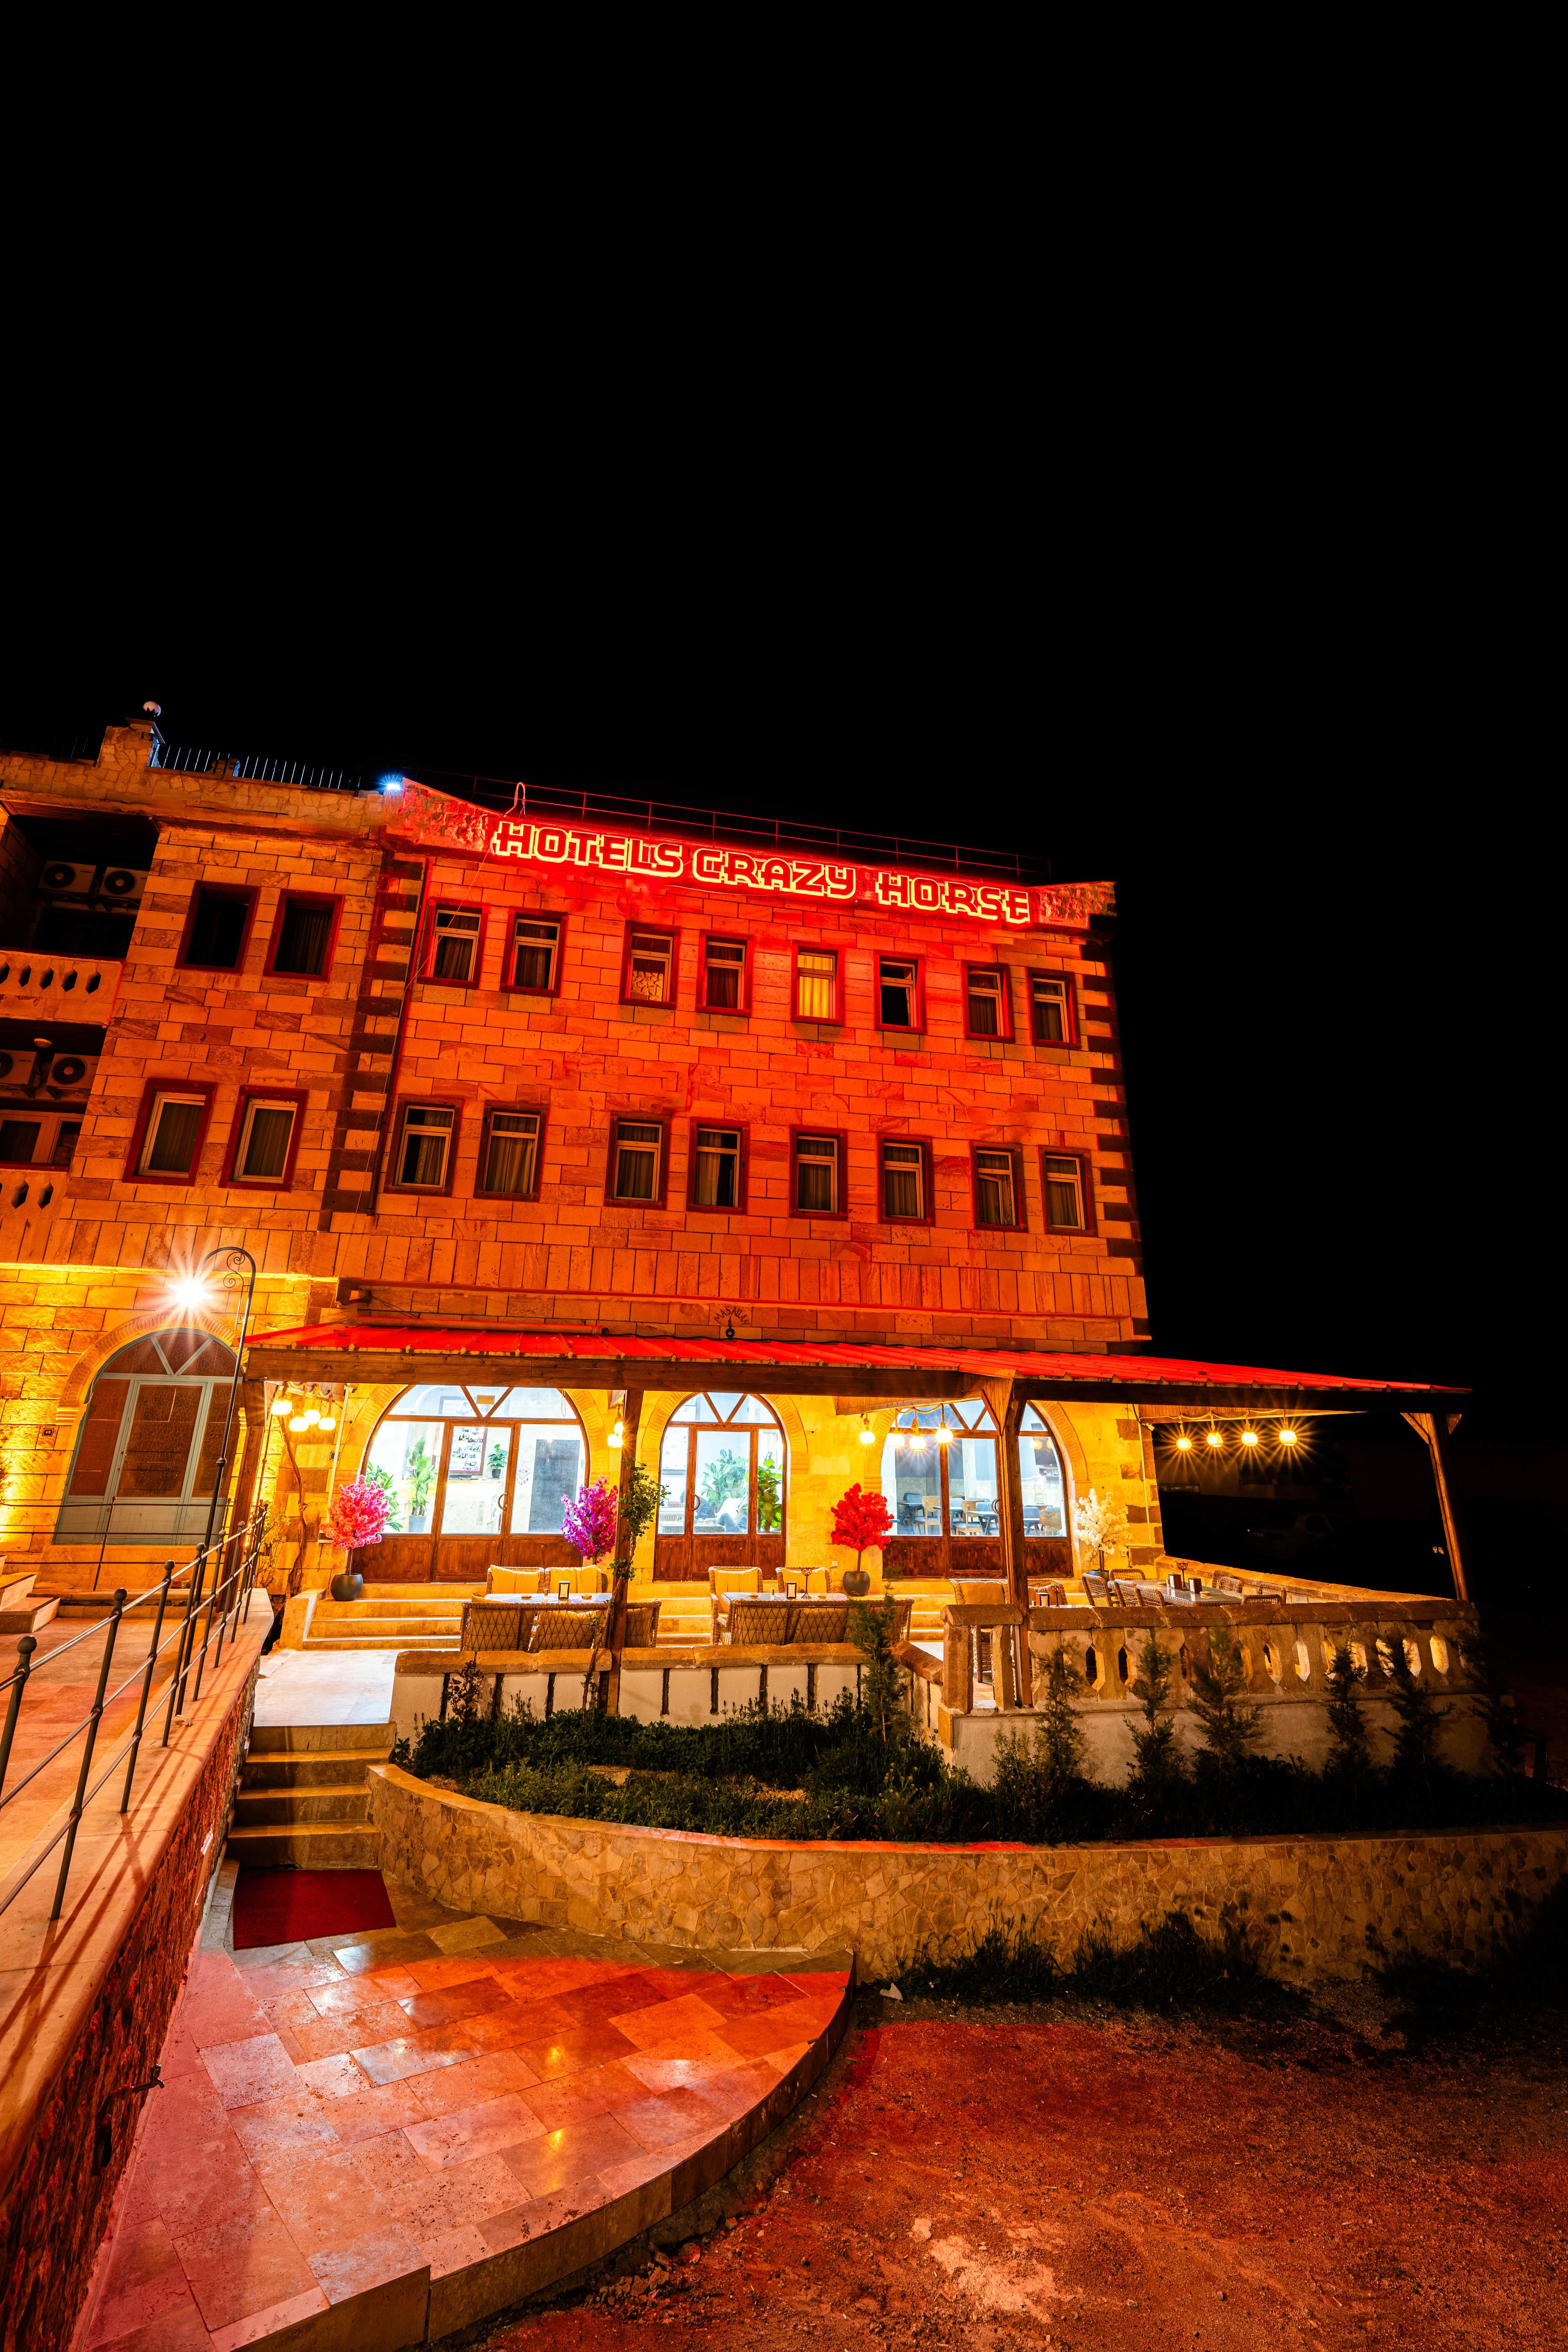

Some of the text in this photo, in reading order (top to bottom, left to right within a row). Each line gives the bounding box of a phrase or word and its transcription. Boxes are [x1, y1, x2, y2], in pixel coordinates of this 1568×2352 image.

[493, 821, 1030, 924] HOTELS CRAZY HORSE
